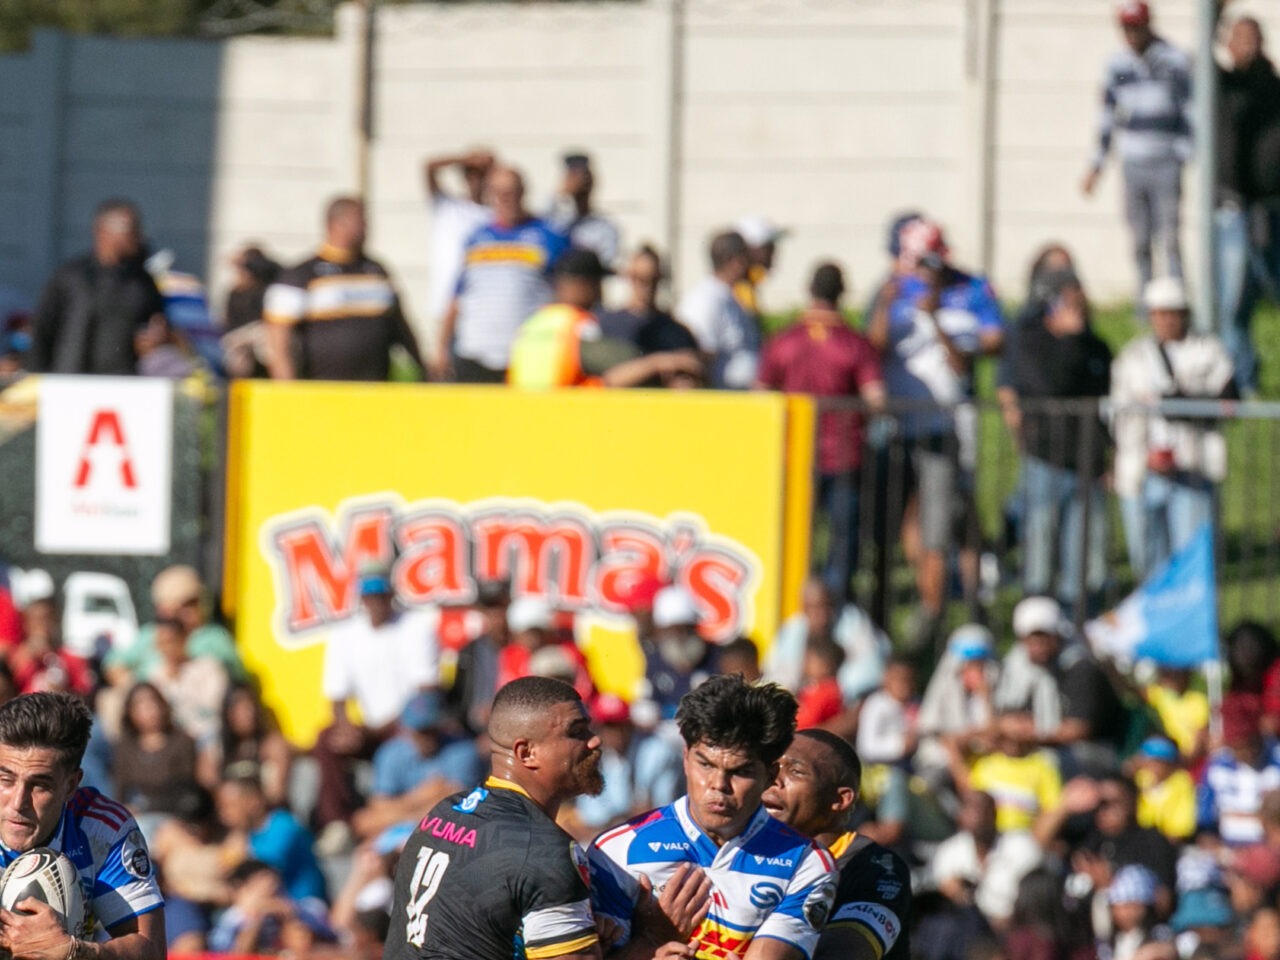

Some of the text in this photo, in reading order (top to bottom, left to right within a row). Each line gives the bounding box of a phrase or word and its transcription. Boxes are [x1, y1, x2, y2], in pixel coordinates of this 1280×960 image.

[274, 504, 750, 645] Mama's
[420, 816, 477, 849] VUMA
[766, 857, 793, 868] VALR
[405, 845, 450, 949] 12
